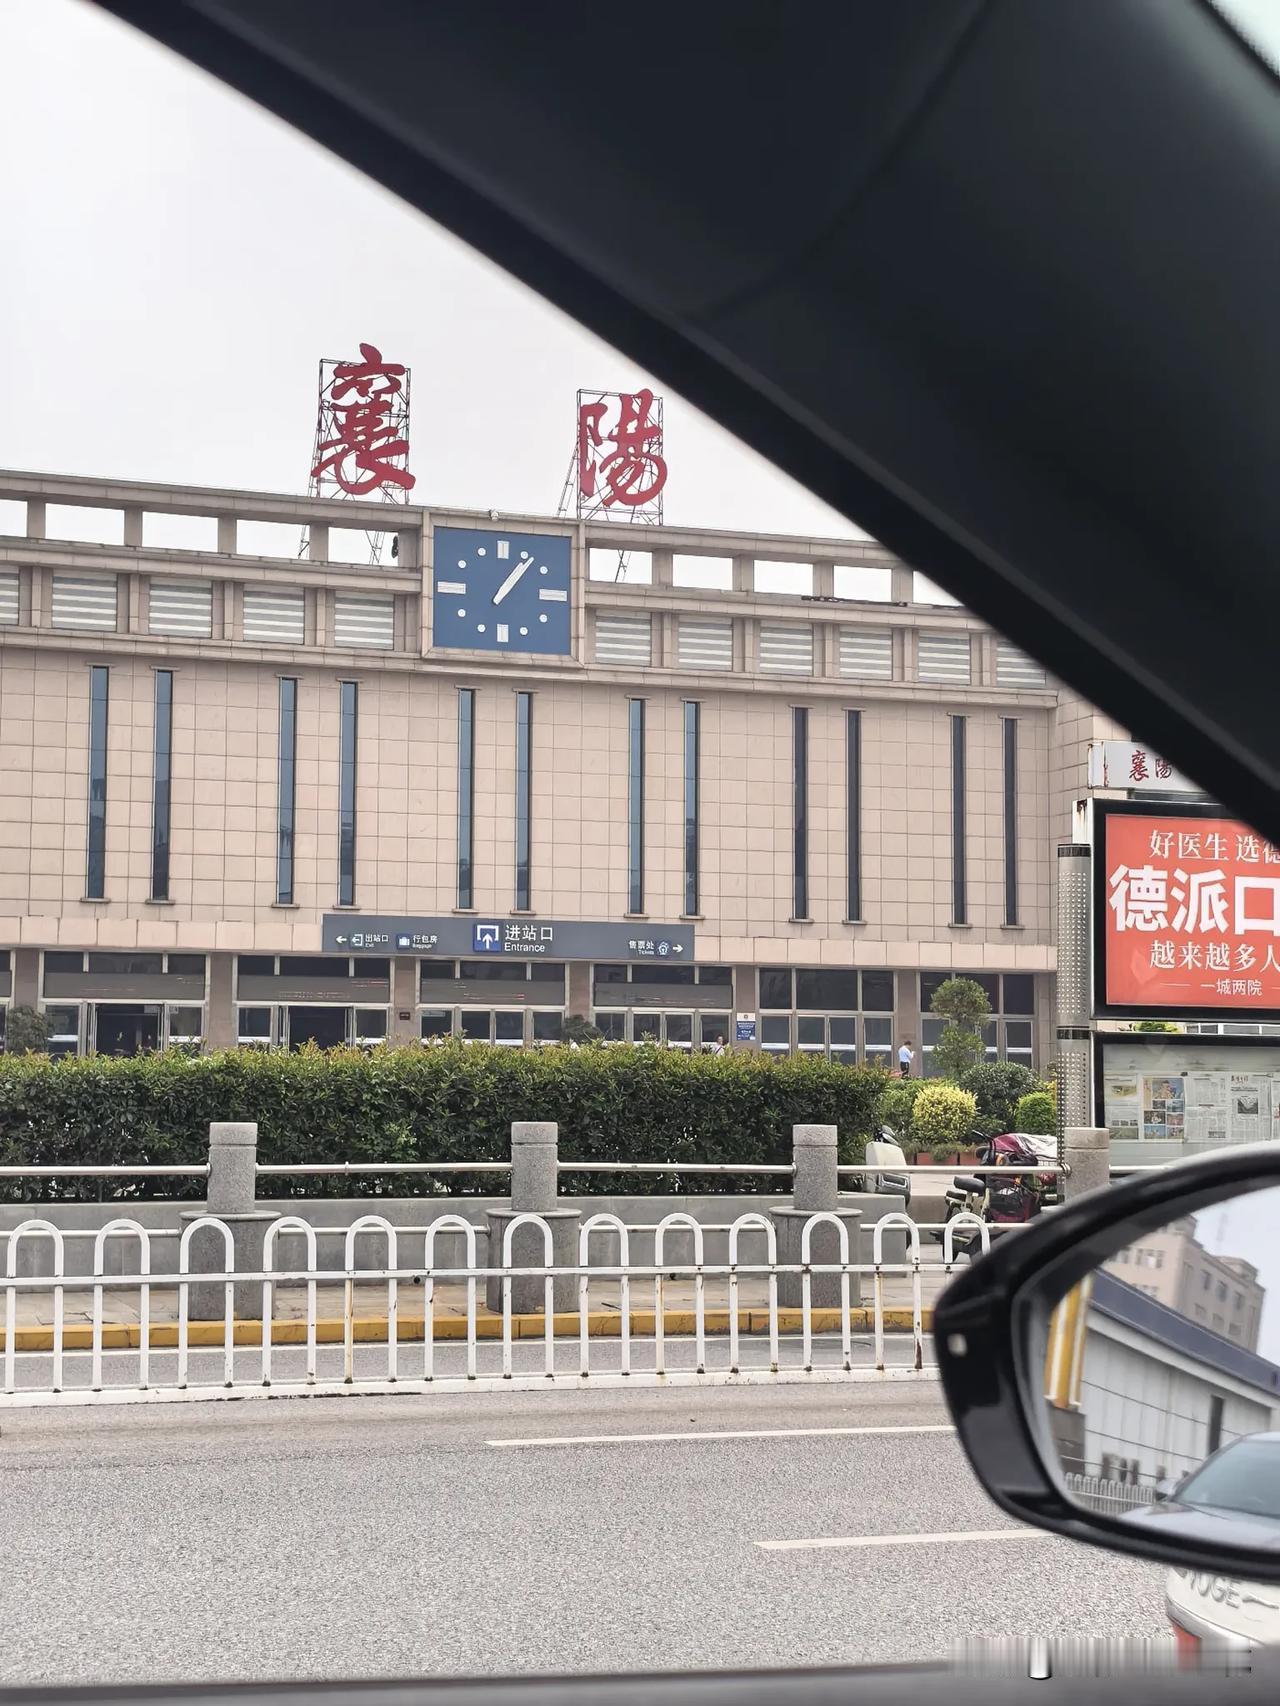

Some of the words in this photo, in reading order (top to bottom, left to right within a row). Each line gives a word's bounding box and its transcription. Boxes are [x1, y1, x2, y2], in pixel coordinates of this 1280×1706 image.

[1109, 864, 1280, 937] 德派口
[365, 933, 389, 943] 出站口
[413, 934, 438, 944] 行包房
[505, 925, 553, 941] 进站口
[504, 942, 546, 952] Entrance
[629, 940, 655, 950] 售票处
[1149, 939, 1280, 973] 越来越多人
[1200, 978, 1263, 997] 一城两院
